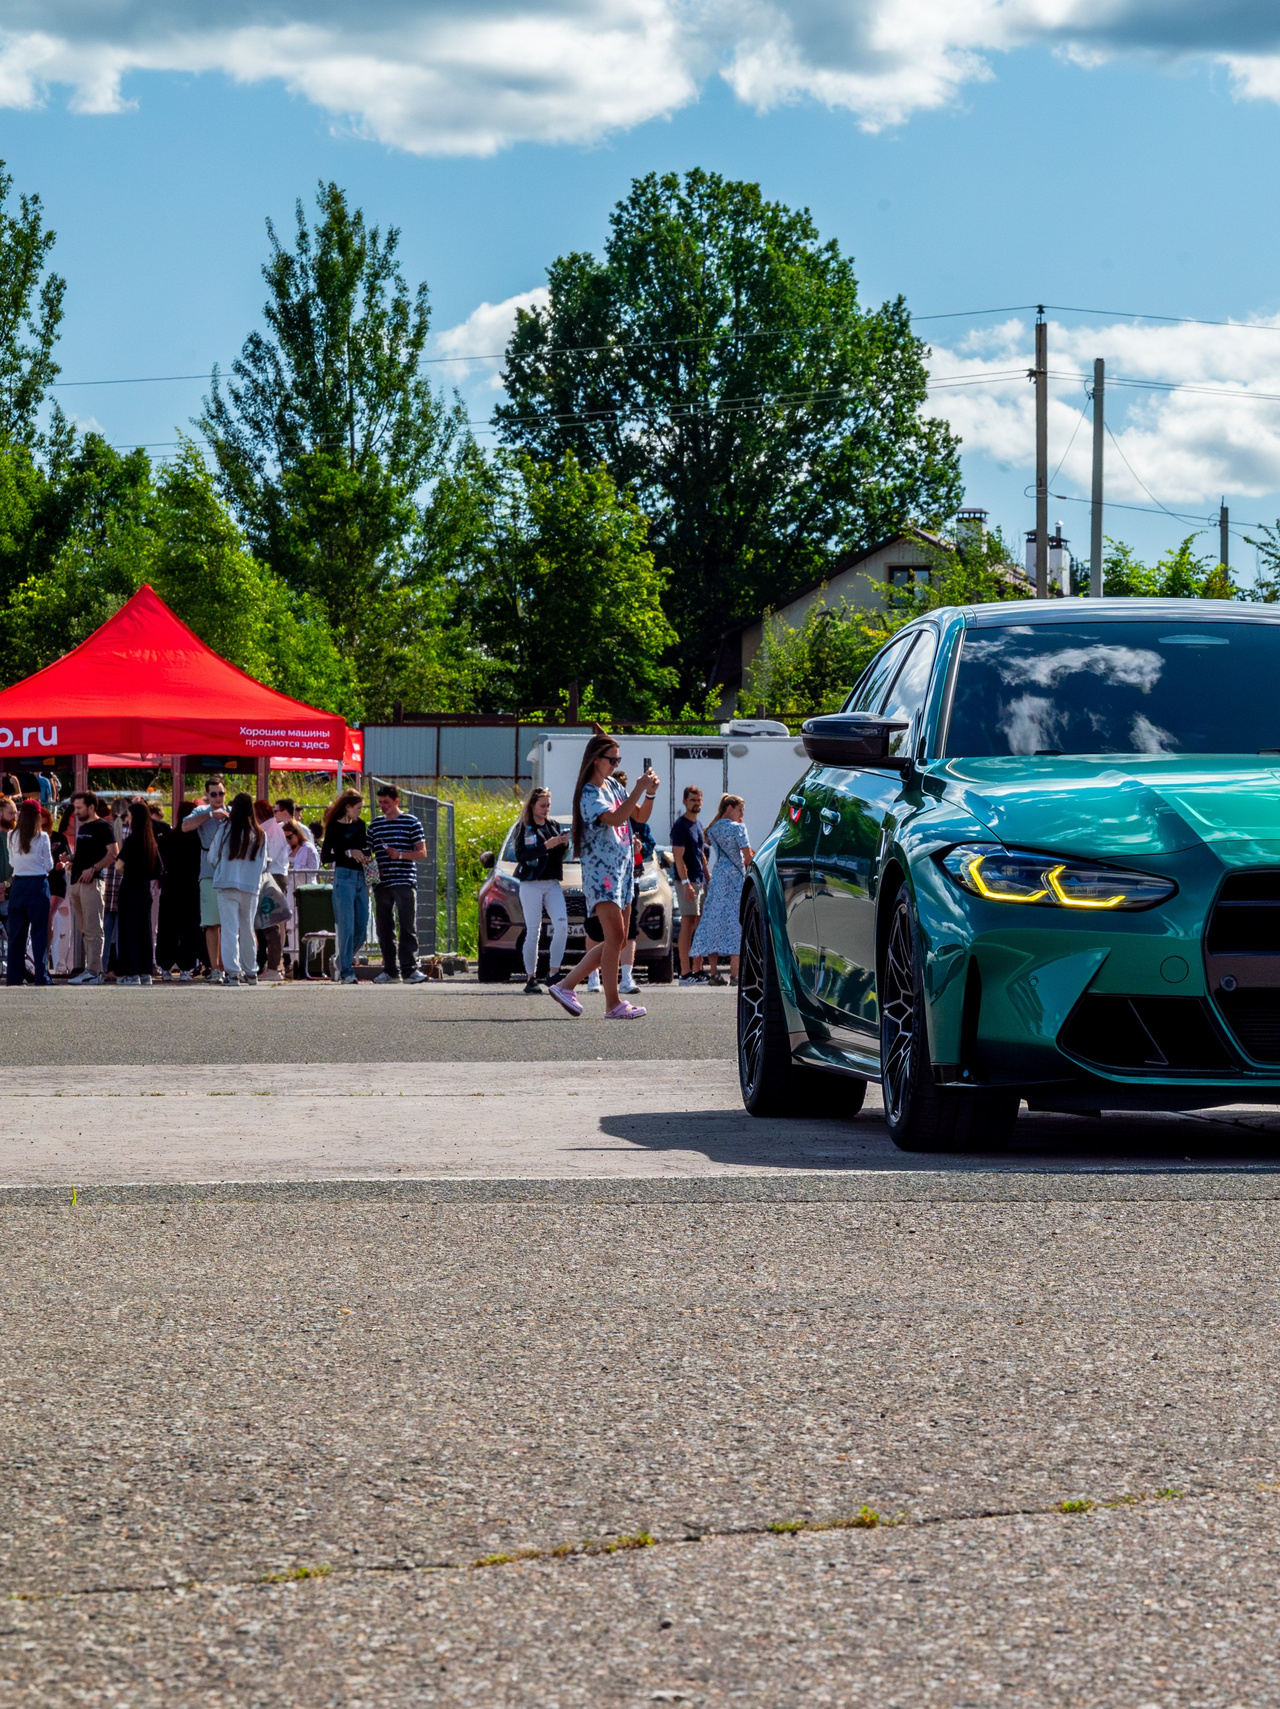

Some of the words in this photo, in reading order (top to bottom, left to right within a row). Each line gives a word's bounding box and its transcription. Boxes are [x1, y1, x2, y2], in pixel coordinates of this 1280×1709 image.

[0, 726, 58, 748] o.ru
[240, 726, 286, 737] Хорошие
[288, 729, 330, 738] машины
[245, 738, 300, 748] продаются
[302, 742, 330, 750] здесь
[688, 748, 709, 759] WC
